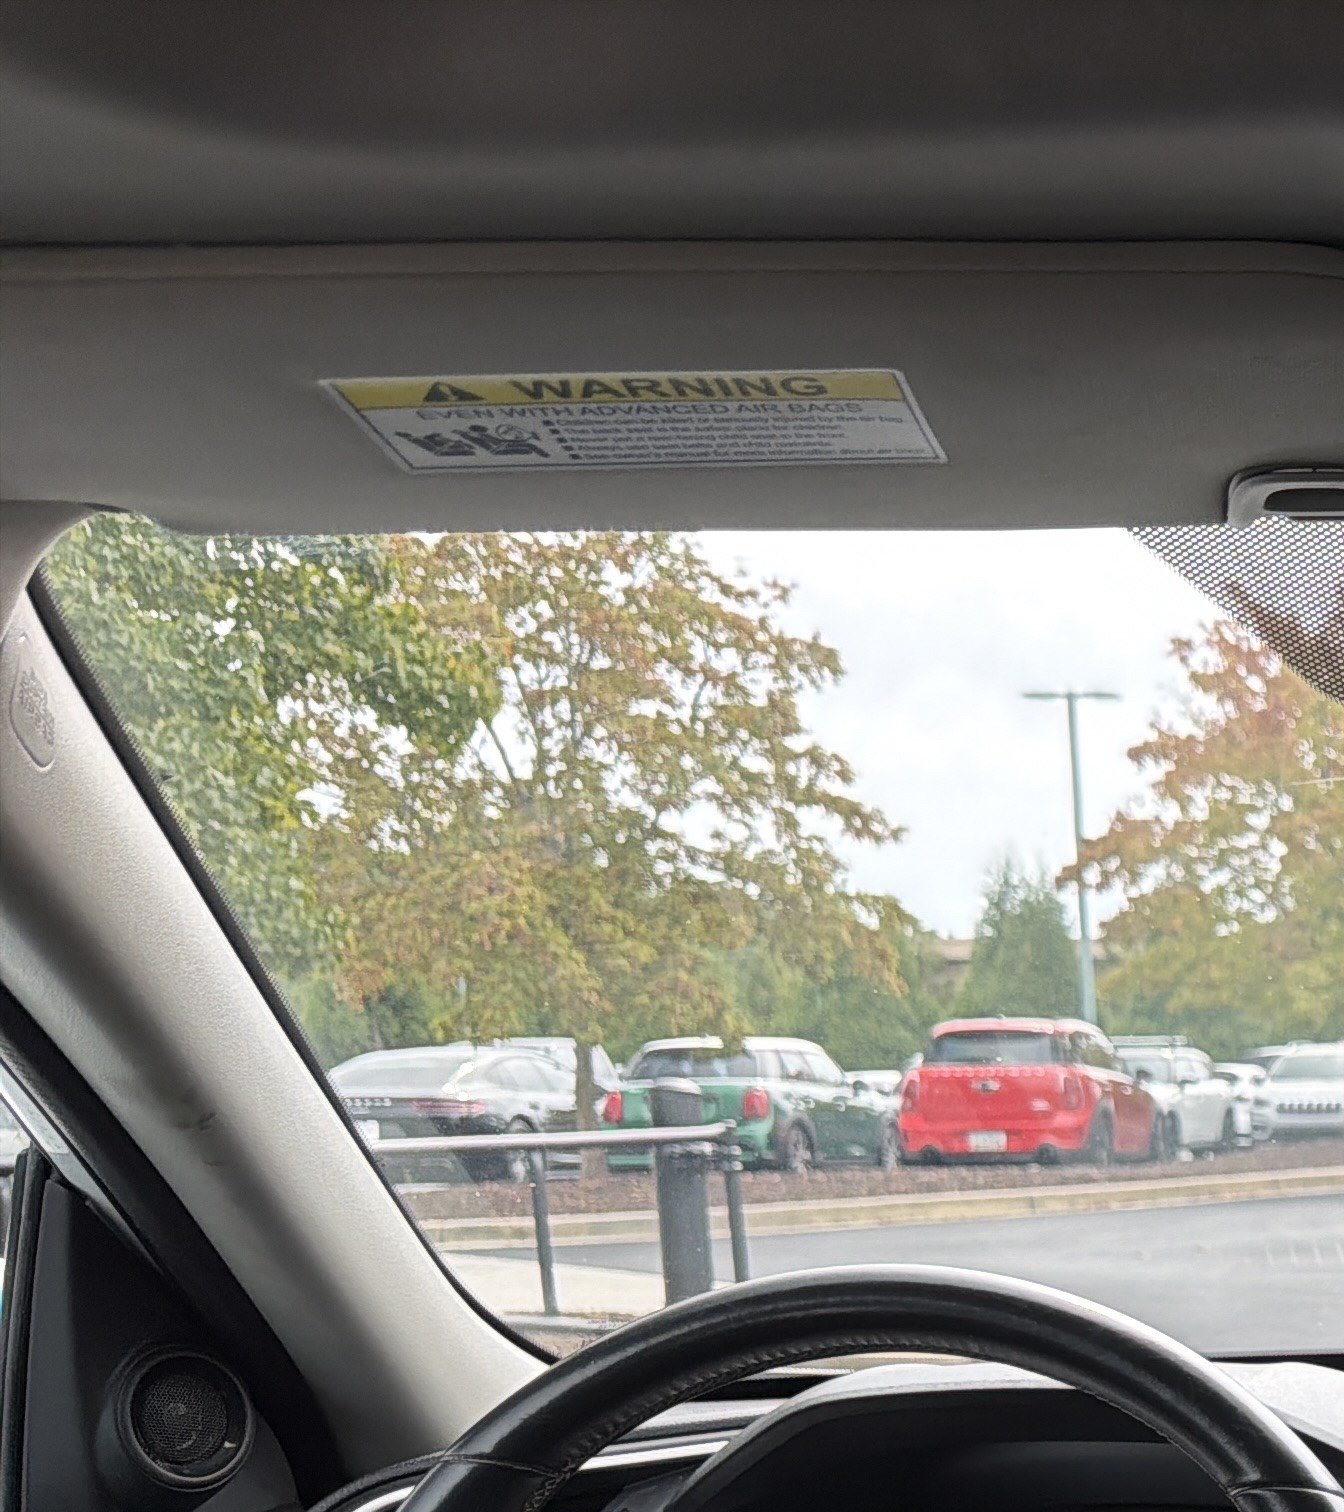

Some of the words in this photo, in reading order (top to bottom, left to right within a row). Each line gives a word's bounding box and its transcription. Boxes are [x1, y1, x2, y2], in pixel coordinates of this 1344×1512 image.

[508, 377, 828, 399] WARNING
[500, 406, 571, 419] WITH
[580, 402, 729, 417] ADVANCED
[737, 402, 781, 415] AIR
[789, 401, 863, 414] BAGS
